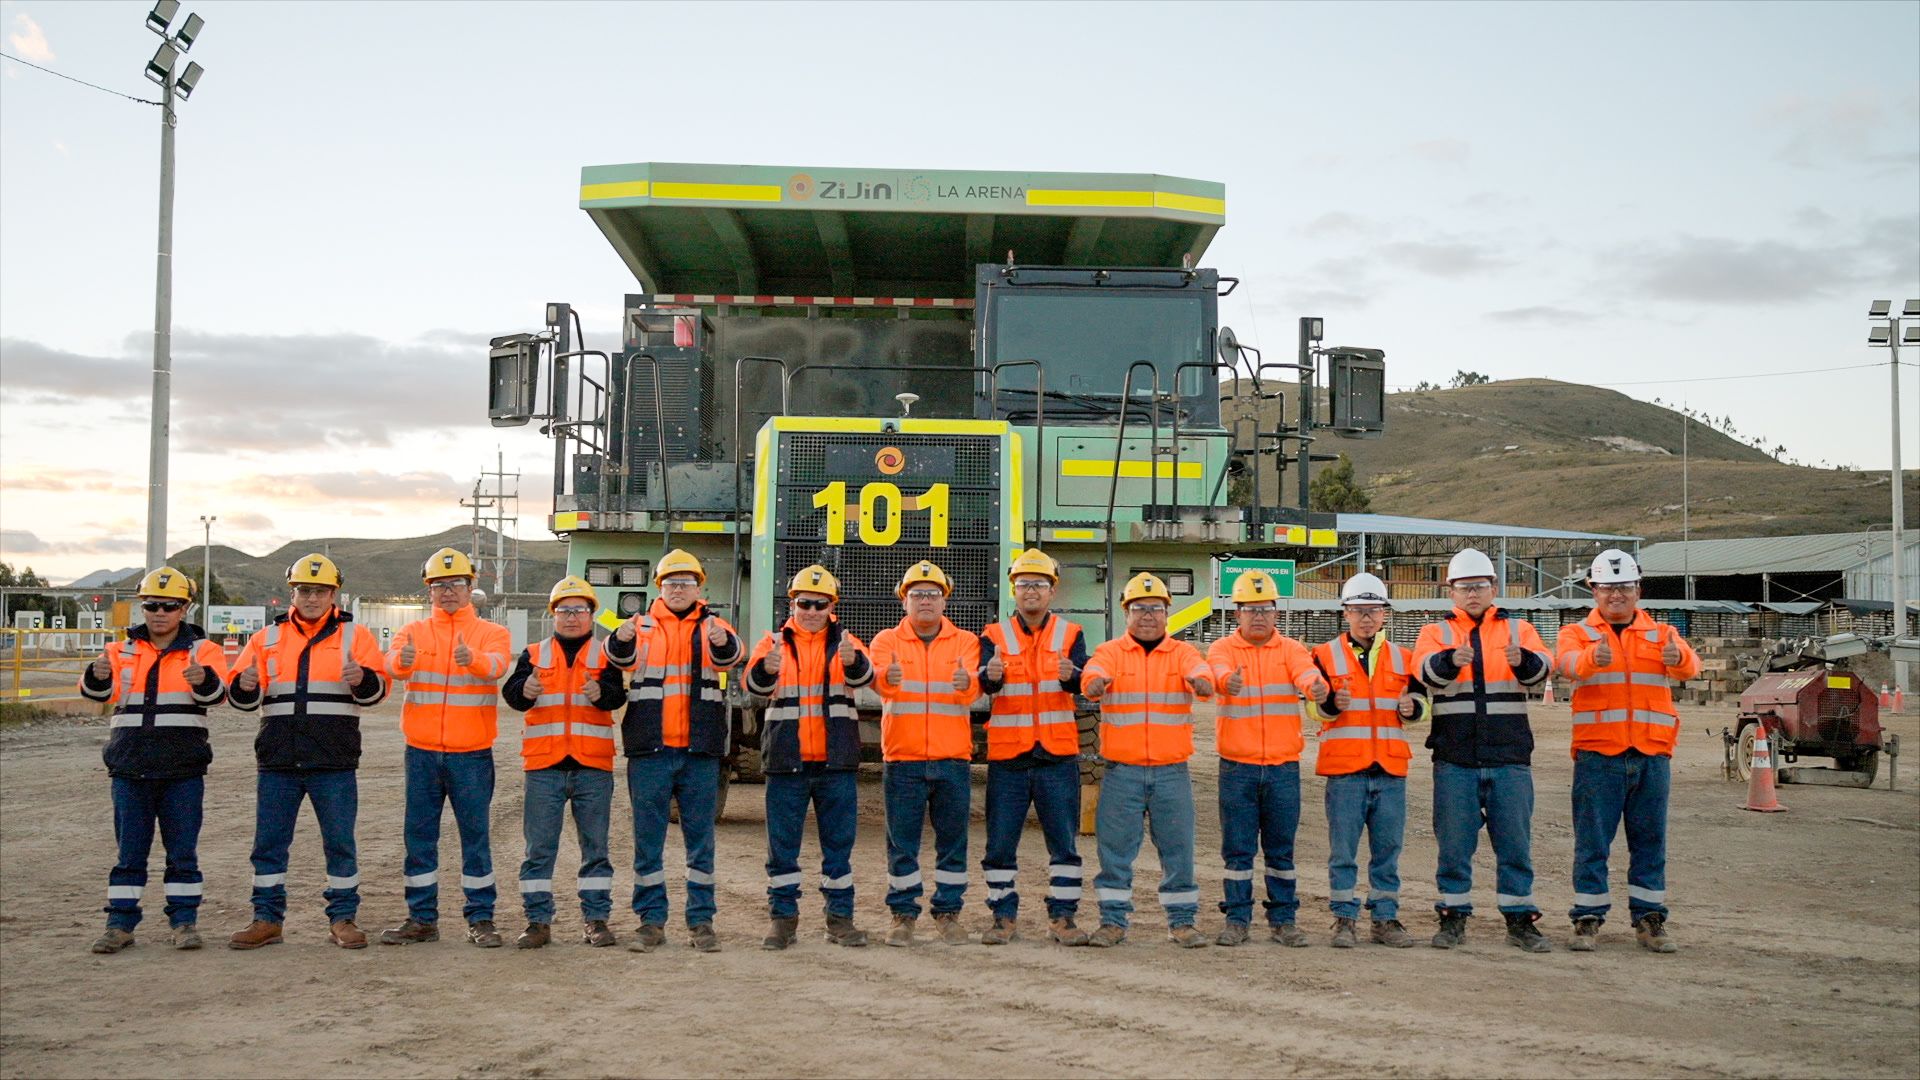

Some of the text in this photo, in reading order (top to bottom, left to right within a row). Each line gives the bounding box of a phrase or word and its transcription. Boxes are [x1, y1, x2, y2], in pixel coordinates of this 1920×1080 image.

[819, 181, 892, 200] ZiJin
[937, 185, 1025, 199] LA ARENA
[812, 481, 949, 547] 101
